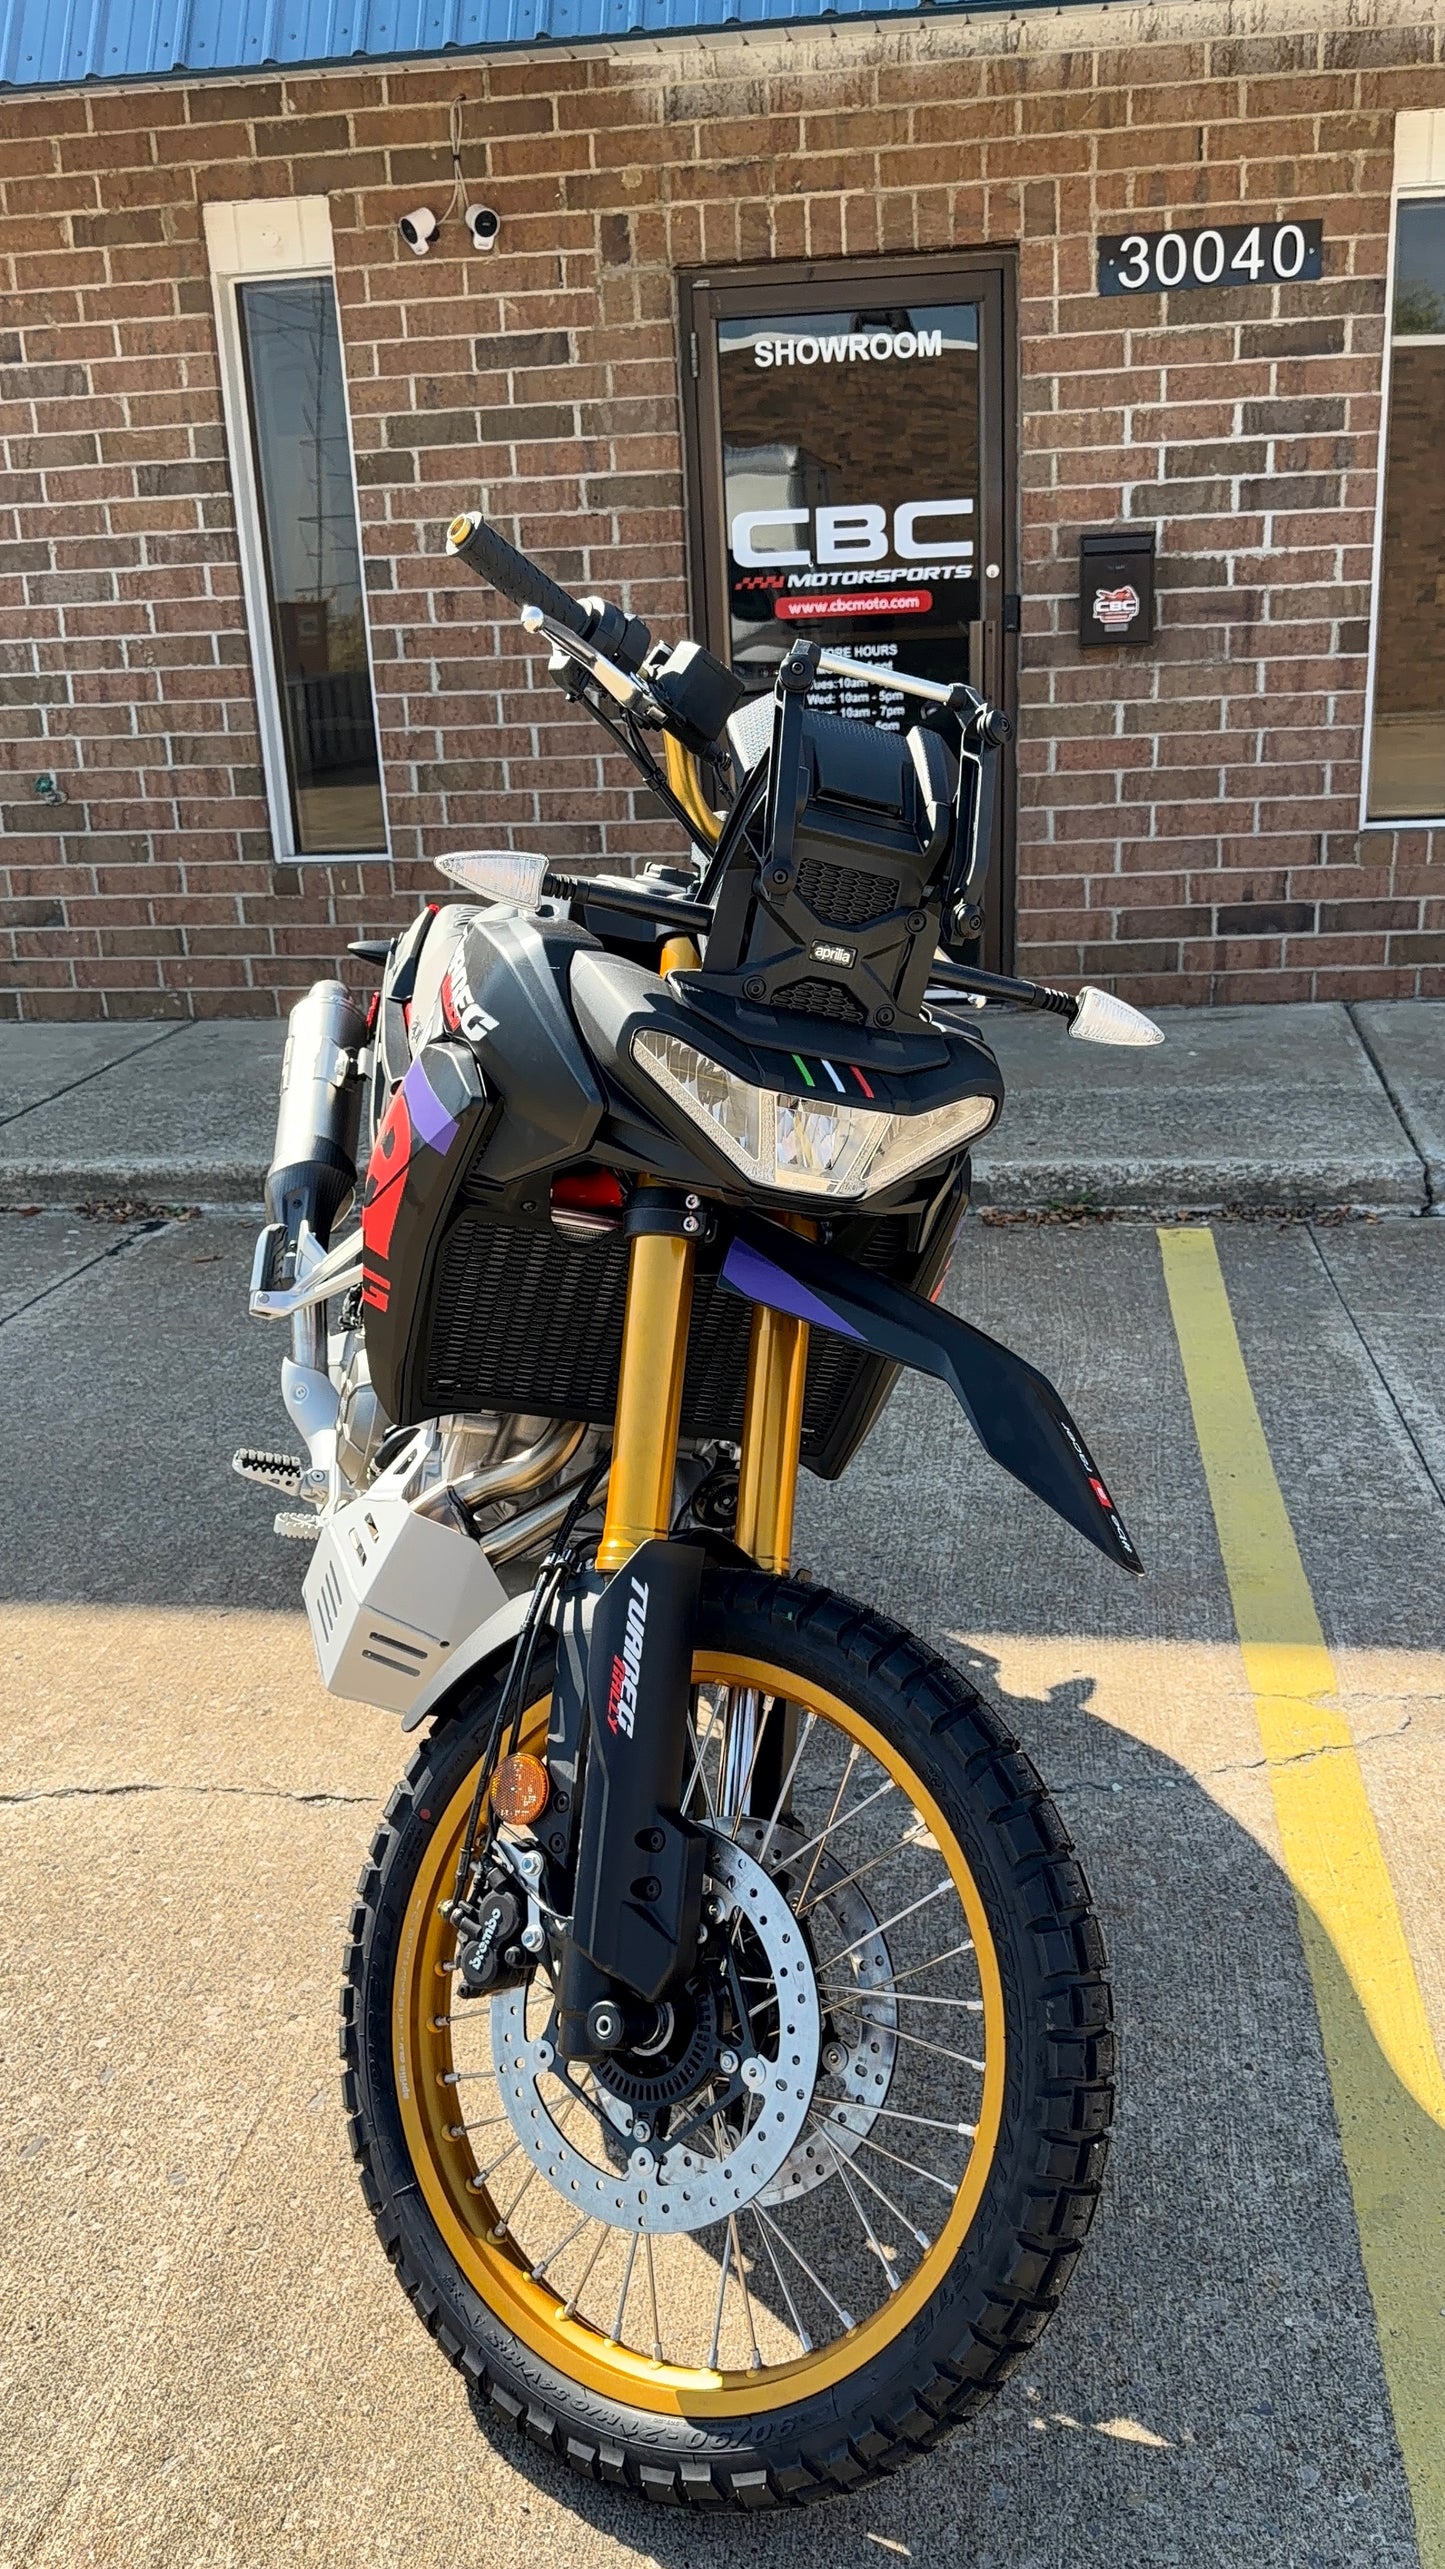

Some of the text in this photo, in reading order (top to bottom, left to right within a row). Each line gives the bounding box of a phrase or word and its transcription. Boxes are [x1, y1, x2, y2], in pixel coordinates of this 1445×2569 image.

[1118, 225, 1305, 289] 30040
[754, 330, 942, 368] SHOWROOM
[731, 499, 974, 568] CBC
[787, 564, 974, 589] MOTORSPORTS
[788, 595, 920, 615] www.cbcmoto.com
[854, 643, 899, 658] HOURS
[806, 693, 836, 706] Wed:
[838, 691, 870, 704] 10am
[879, 690, 905, 704] 5pm
[840, 706, 871, 719] 10am
[879, 705, 906, 719] 7pm
[814, 944, 851, 964] aprilia
[616, 1576, 650, 1740] TUAREG
[607, 1654, 627, 1737] RALLY
[469, 1907, 501, 1971] brembo
